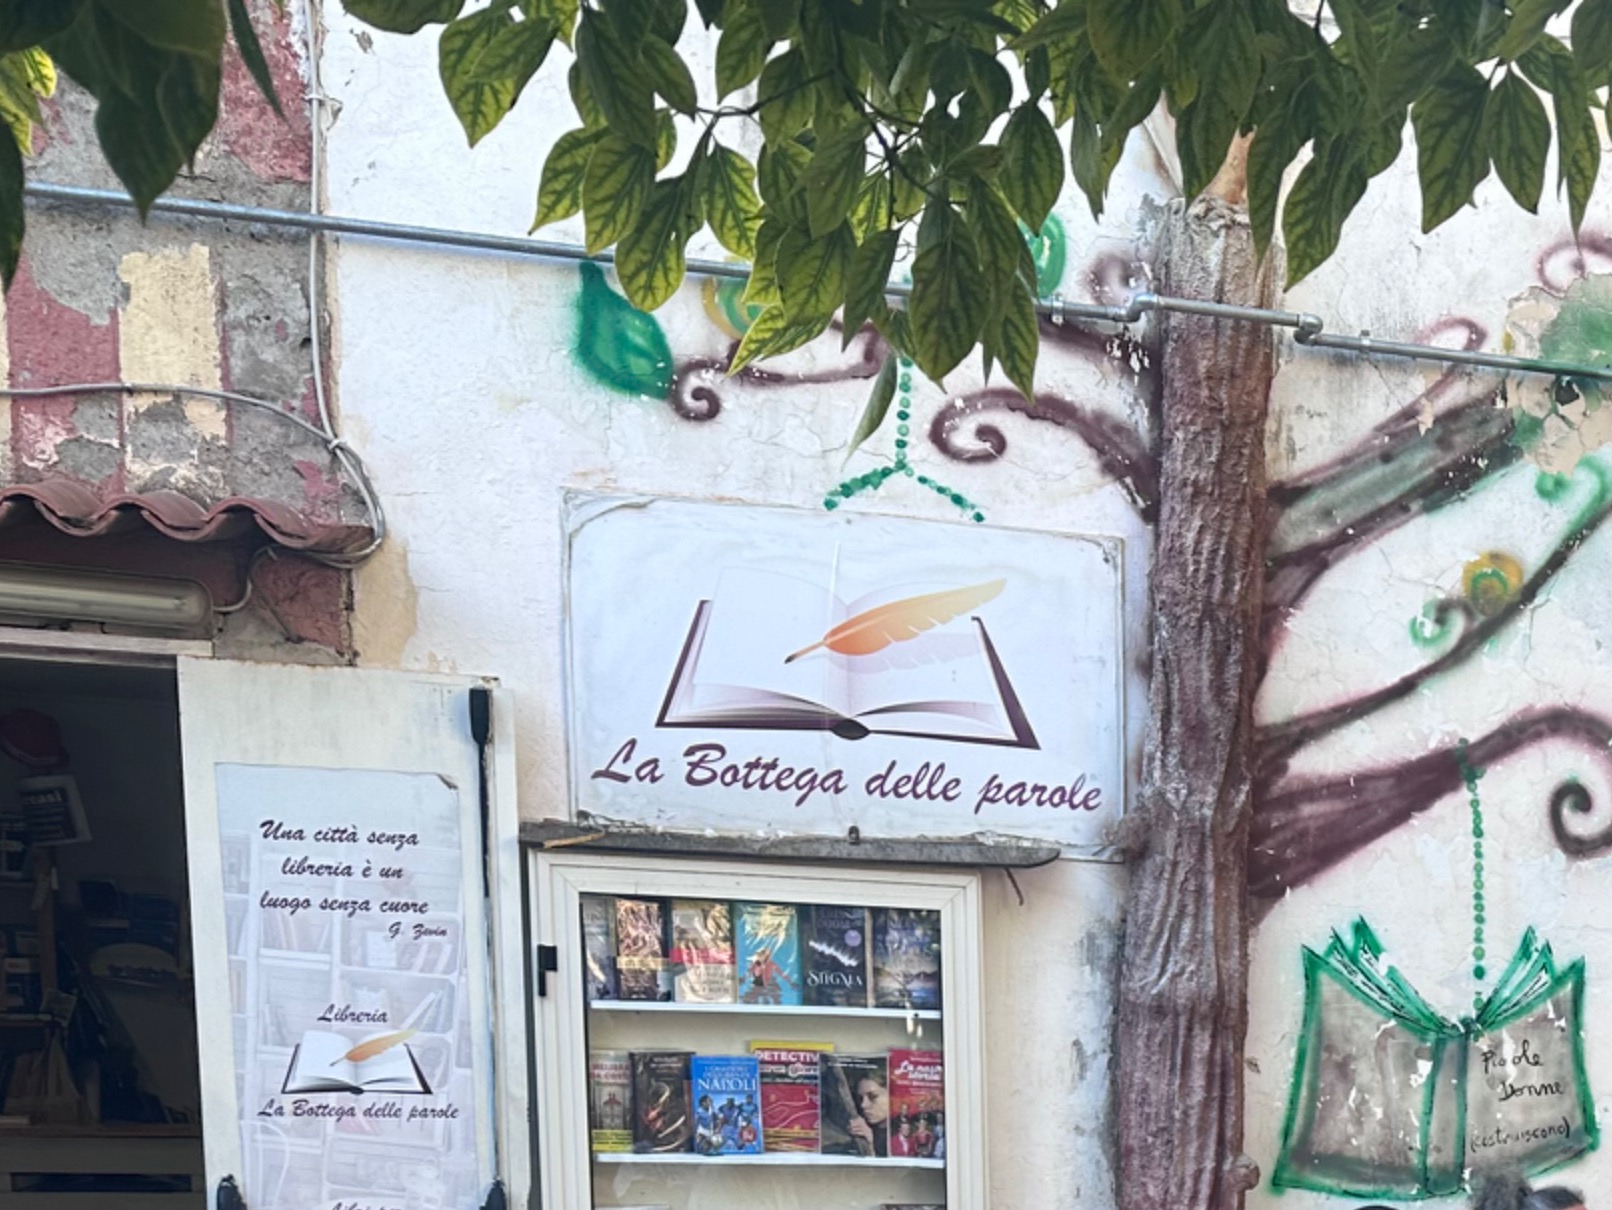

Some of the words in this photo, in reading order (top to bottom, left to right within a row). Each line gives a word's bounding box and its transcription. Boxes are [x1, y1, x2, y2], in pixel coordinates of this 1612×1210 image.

[591, 738, 664, 784] La
[682, 743, 848, 807] Bottega
[865, 758, 961, 802] delle
[974, 772, 1102, 814] parole
[259, 819, 305, 842] Una
[313, 824, 359, 844] città
[367, 830, 420, 851] senza
[281, 856, 353, 878] libreria
[362, 859, 372, 878] è
[379, 865, 404, 879] un
[260, 891, 311, 916] luogo
[319, 897, 371, 918] senza
[380, 899, 429, 915] cuore
[317, 1004, 388, 1023] Libreria
[697, 1077, 757, 1091] NAPOLI
[257, 1099, 284, 1118] La
[292, 1100, 355, 1121] Bottega
[363, 1102, 402, 1119] delle
[407, 1103, 458, 1121] parole
